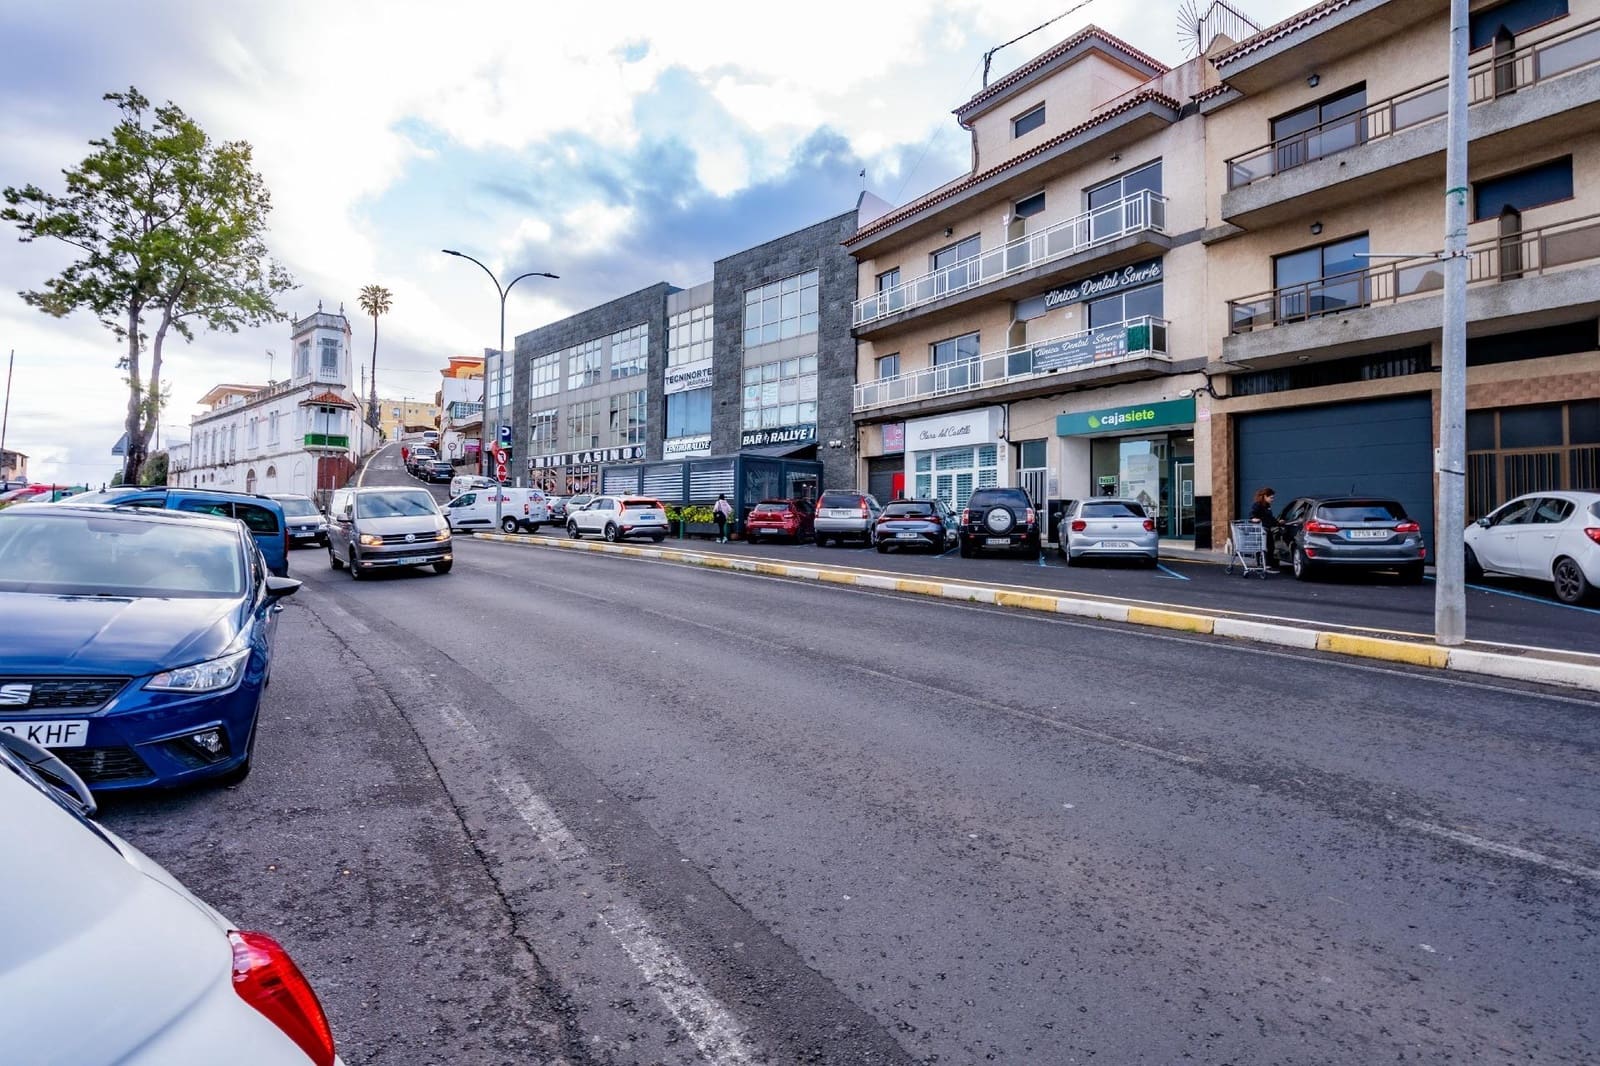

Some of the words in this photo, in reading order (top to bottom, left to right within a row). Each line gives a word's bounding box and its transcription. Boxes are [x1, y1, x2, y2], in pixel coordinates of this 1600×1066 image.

[1081, 271, 1118, 295] Dental
[1062, 338, 1089, 350] Dental
[665, 368, 712, 385] TECNINORTE
[1101, 410, 1155, 426] cajasiete
[742, 433, 762, 446] BAR
[770, 429, 807, 443] RALLYE
[572, 448, 632, 464] KASINO
[28, 724, 81, 744] KHF
